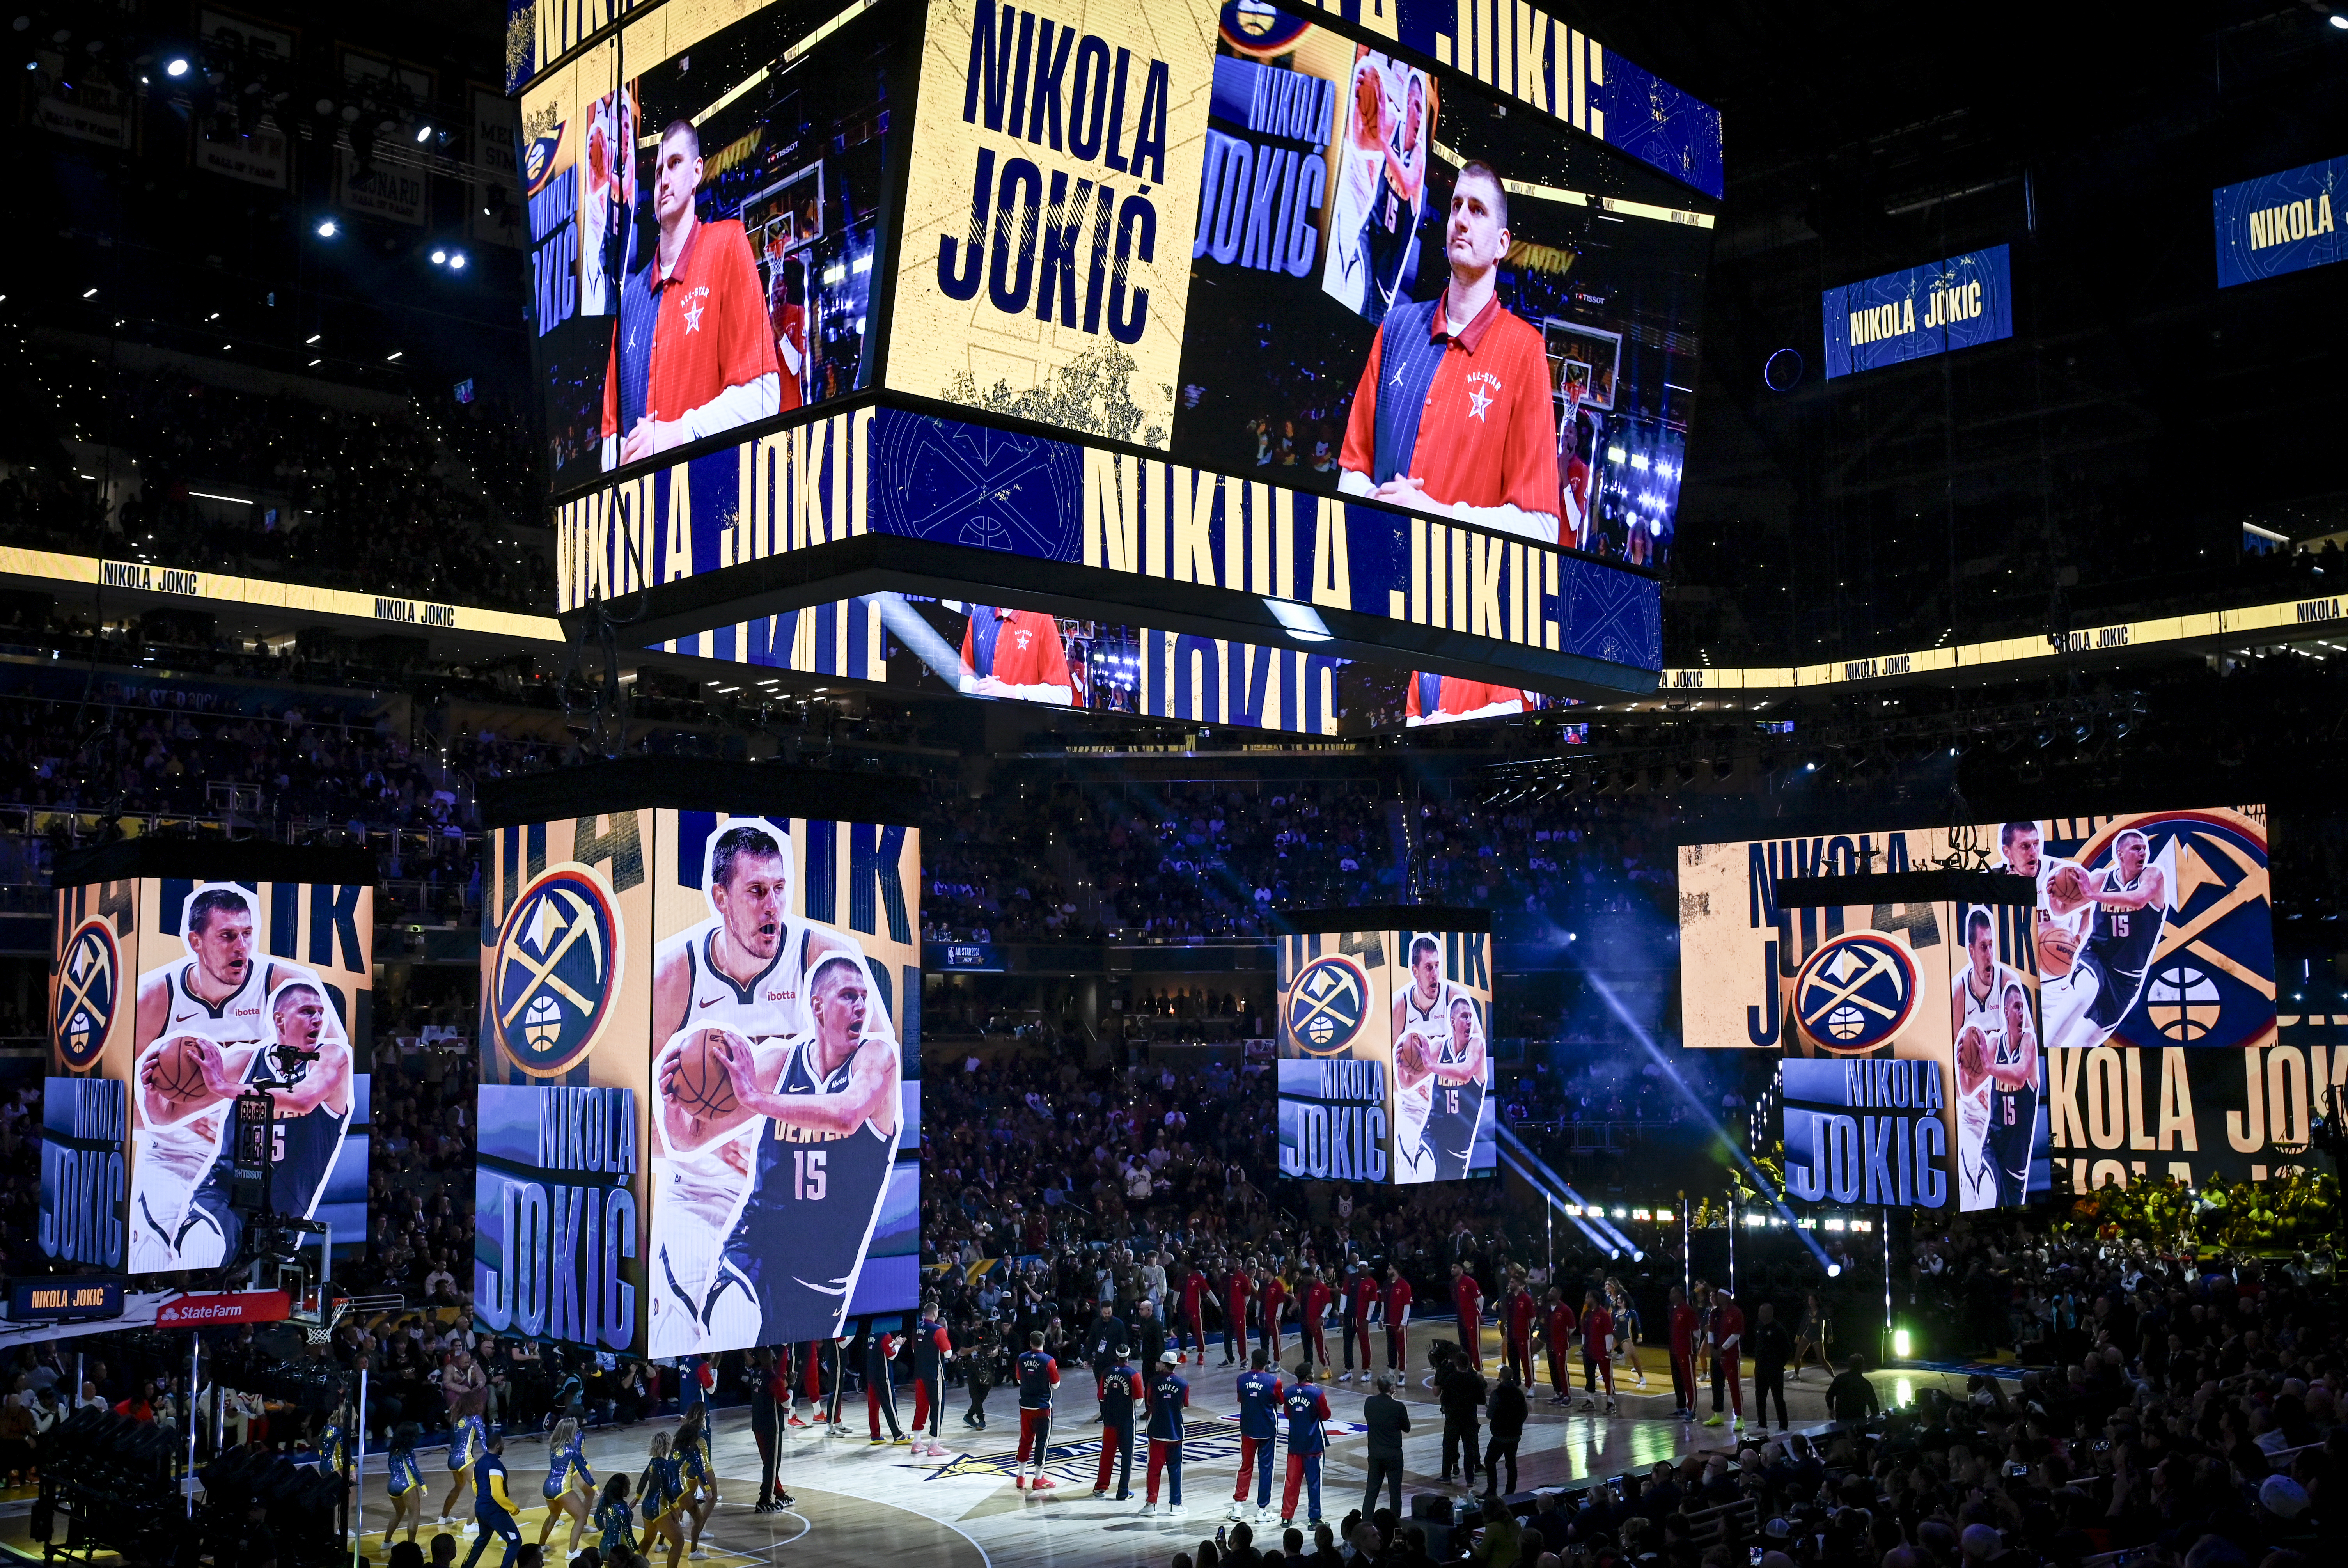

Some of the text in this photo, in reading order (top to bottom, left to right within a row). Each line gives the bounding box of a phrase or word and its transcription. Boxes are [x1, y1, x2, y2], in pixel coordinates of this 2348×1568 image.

[963, 0, 1169, 186] NIKOLA
[1248, 64, 1335, 146] NIKOLA
[486, 147, 517, 172] SIM
[536, 163, 578, 241] NIKOLA
[2249, 194, 2334, 250] NIKOLA
[937, 147, 1157, 344] JOKIĆ
[681, 286, 710, 308] ALL-STAR
[1850, 280, 1981, 347] NIKOLA JOKIĆ
[1467, 372, 1501, 392] ALL-STAR
[104, 562, 151, 589] NIKOLA
[375, 598, 415, 622] NIKOLA
[2297, 599, 2340, 623] NIKOLA
[1014, 629, 1033, 637] ALL-STAR
[1845, 658, 1878, 681] NIKOLA
[2110, 915, 2129, 937] 15
[767, 990, 796, 1002] ibotta
[235, 1008, 260, 1017] ibotta
[831, 1075, 848, 1089] ibotta
[1321, 1060, 1385, 1100] NIKOLA
[1846, 1059, 1943, 1109] NIKOLA
[75, 1078, 125, 1142] NIKOLA
[1445, 1089, 1459, 1114] 15
[2002, 1096, 2016, 1125] 15
[539, 1087, 636, 1174] NIKOLA
[1287, 1100, 1386, 1181] JOKIĆ
[1798, 1108, 1947, 1208] JOKIĆ
[793, 1150, 826, 1200] 15
[45, 1142, 124, 1268] JOKIĆ
[486, 1174, 636, 1350] JOKIĆ
[32, 1290, 68, 1309] NIKOLA
[180, 1304, 242, 1320] State Farm
[679, 1364, 691, 1374] DURANT
[1157, 1384, 1179, 1394] BOOKER
[1245, 1381, 1263, 1391] TOWNS
[1288, 1396, 1311, 1407] EDWARDS
